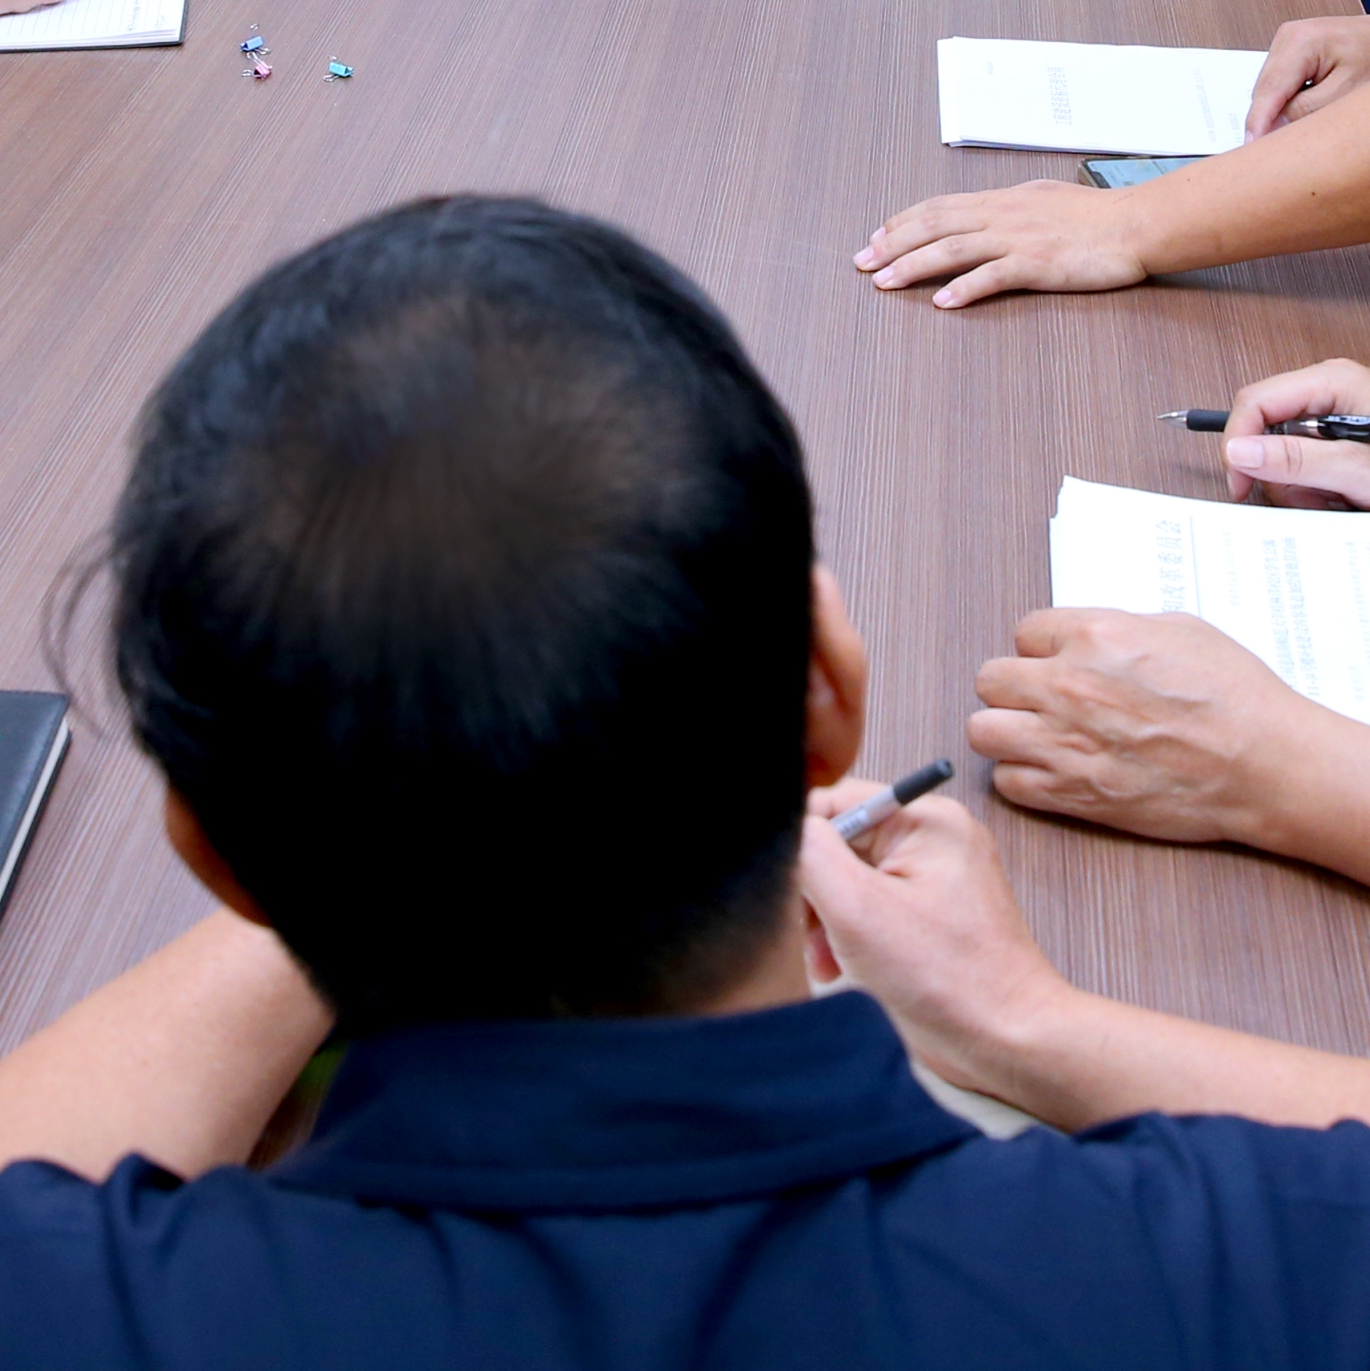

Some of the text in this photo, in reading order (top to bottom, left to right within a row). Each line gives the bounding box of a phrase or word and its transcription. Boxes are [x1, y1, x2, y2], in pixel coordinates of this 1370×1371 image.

[1155, 519, 1186, 613] 和改革委员会
